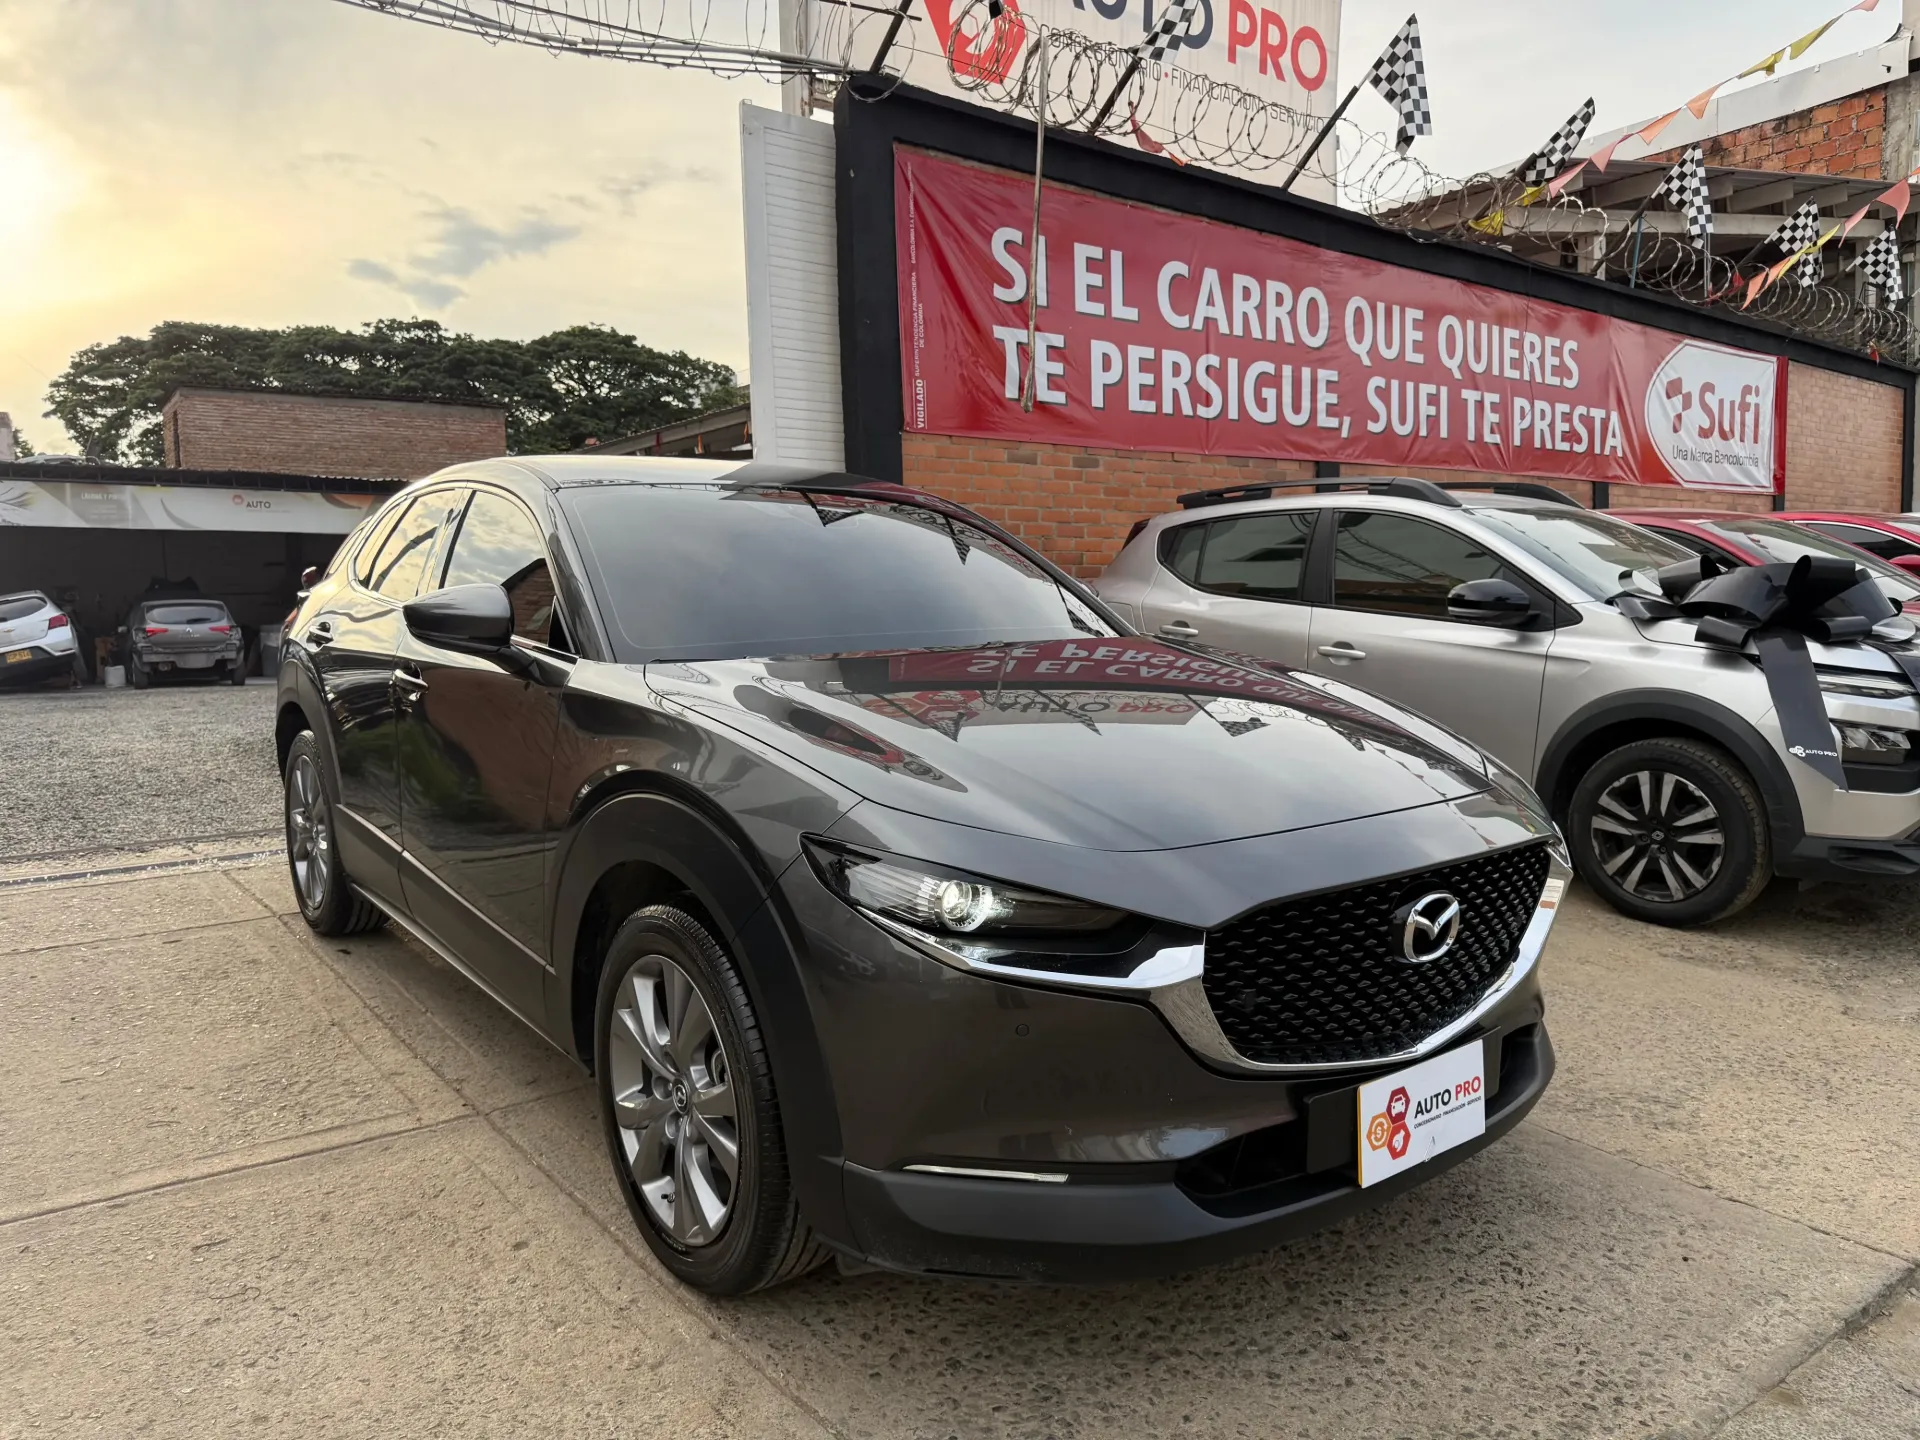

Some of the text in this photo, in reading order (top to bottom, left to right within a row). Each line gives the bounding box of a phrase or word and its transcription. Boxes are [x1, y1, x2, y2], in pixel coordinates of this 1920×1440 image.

[1227, 0, 1328, 92] PRO
[1270, 101, 1327, 135] SERVICIO
[991, 226, 1580, 390] SI EL CARRO QUE QUIERES
[919, 339, 925, 348] DE
[915, 379, 925, 429] VIGILADO
[992, 325, 1624, 458] TE PERSIGUE, SUFI TE PRESTA
[1697, 381, 1761, 445] Sufi
[1672, 445, 1759, 468] Una Marca Bancolombia
[246, 500, 272, 509] AUTO
[1414, 1076, 1481, 1119] AUTO PRO
